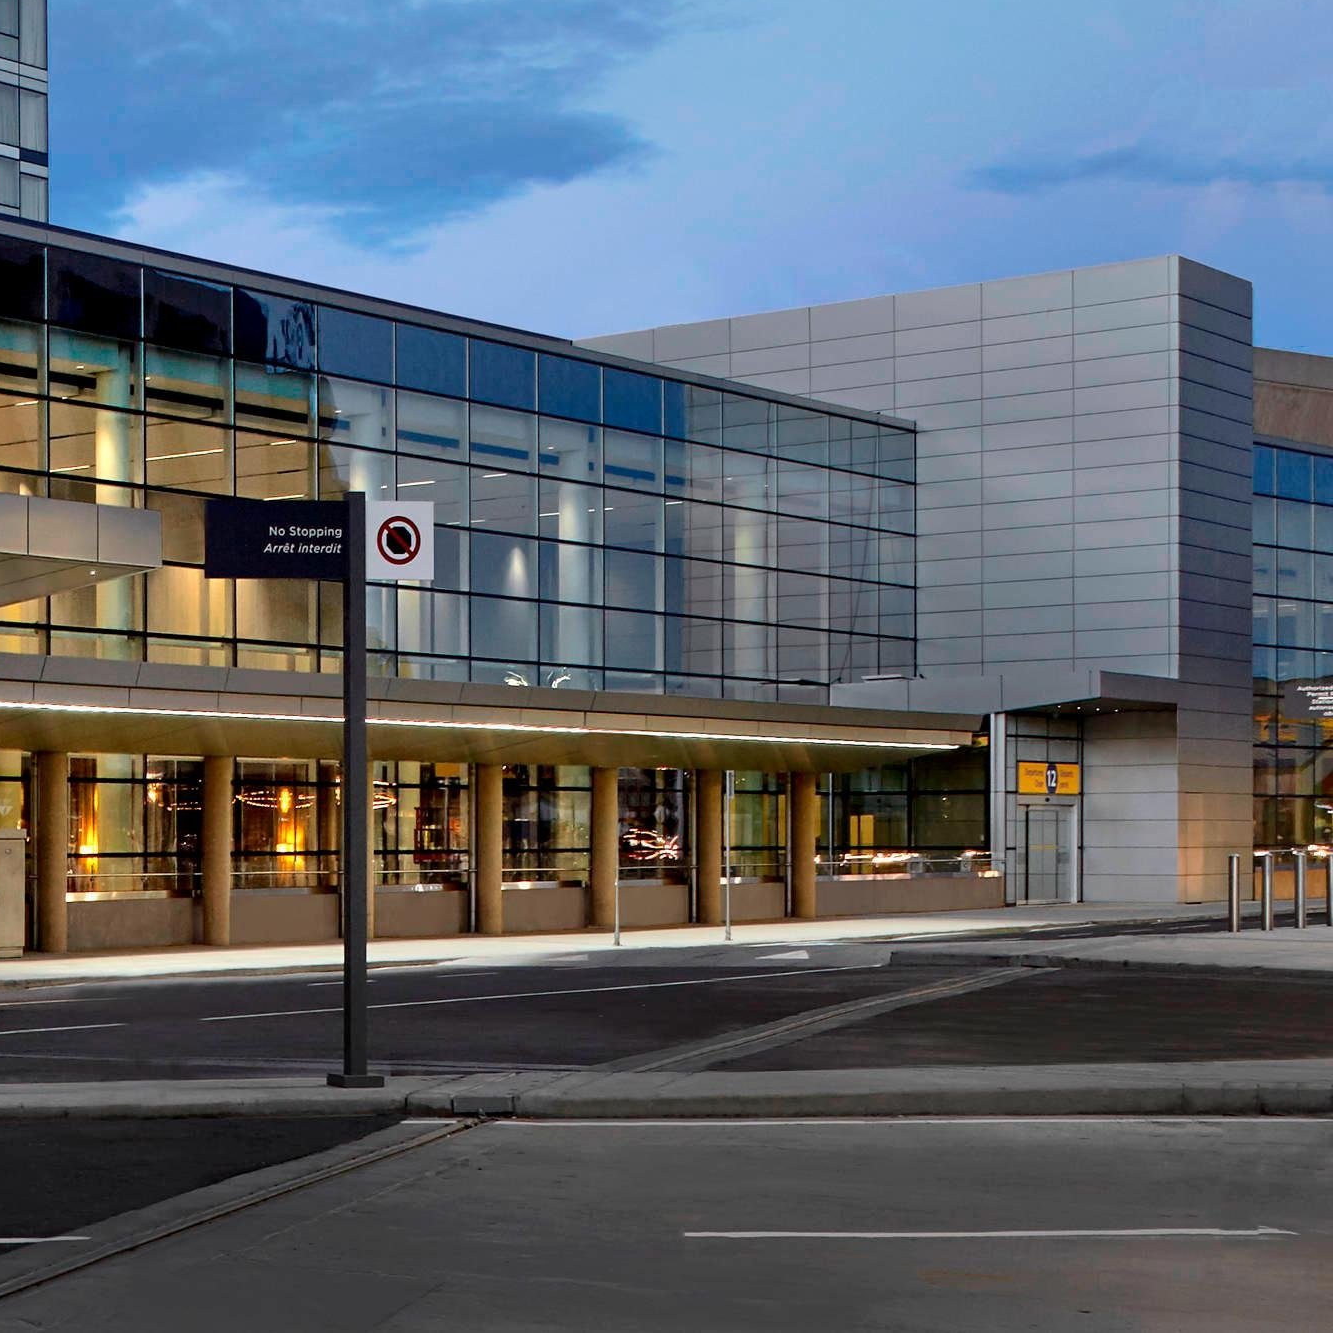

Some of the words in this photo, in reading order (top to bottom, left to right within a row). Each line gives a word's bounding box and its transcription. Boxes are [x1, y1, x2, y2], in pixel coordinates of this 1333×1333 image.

[268, 526, 286, 537] No
[289, 526, 342, 538] Stopping
[263, 542, 295, 554] Arrêt
[297, 542, 342, 554] interdit
[1046, 769, 1057, 787] 12
